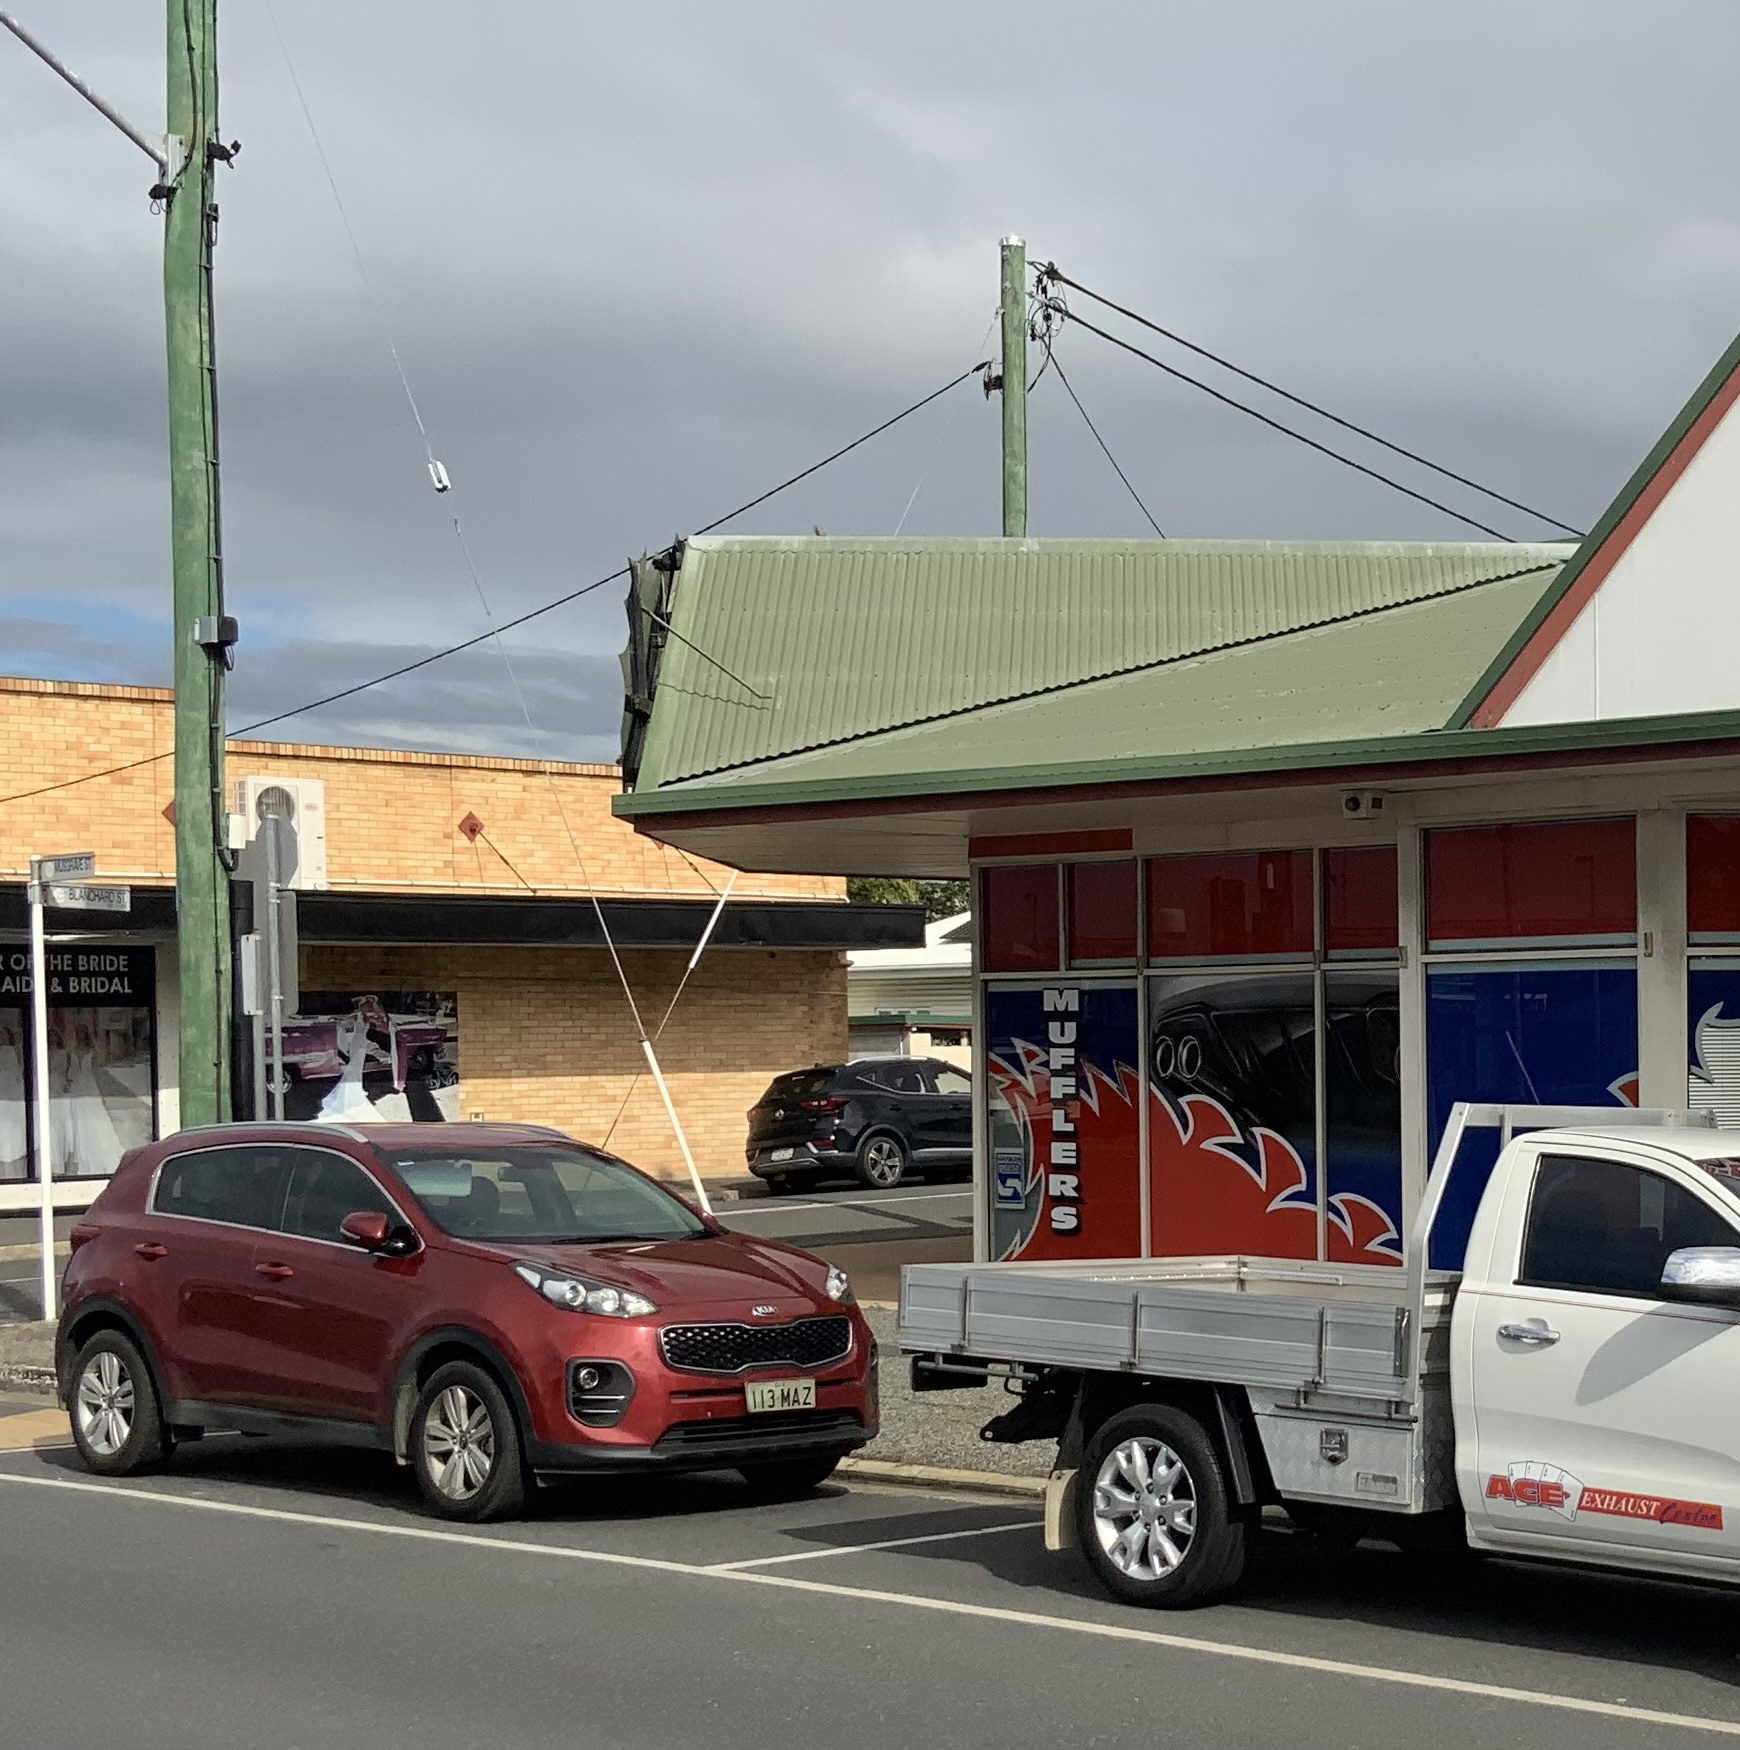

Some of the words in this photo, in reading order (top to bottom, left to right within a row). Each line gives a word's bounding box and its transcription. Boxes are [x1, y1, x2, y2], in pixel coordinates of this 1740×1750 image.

[117, 891, 126, 905] ST
[45, 954, 73, 971] HE
[78, 954, 129, 972] BRIDE
[0, 975, 35, 993] AID
[50, 977, 63, 993] &
[68, 976, 133, 994] BRIDAL
[1043, 988, 1080, 1230] MUFFLERS
[752, 1389, 775, 1409] 113
[780, 1386, 812, 1408] MAZ
[1485, 1474, 1565, 1508] ACE
[1581, 1491, 1660, 1516] EXHAUST
